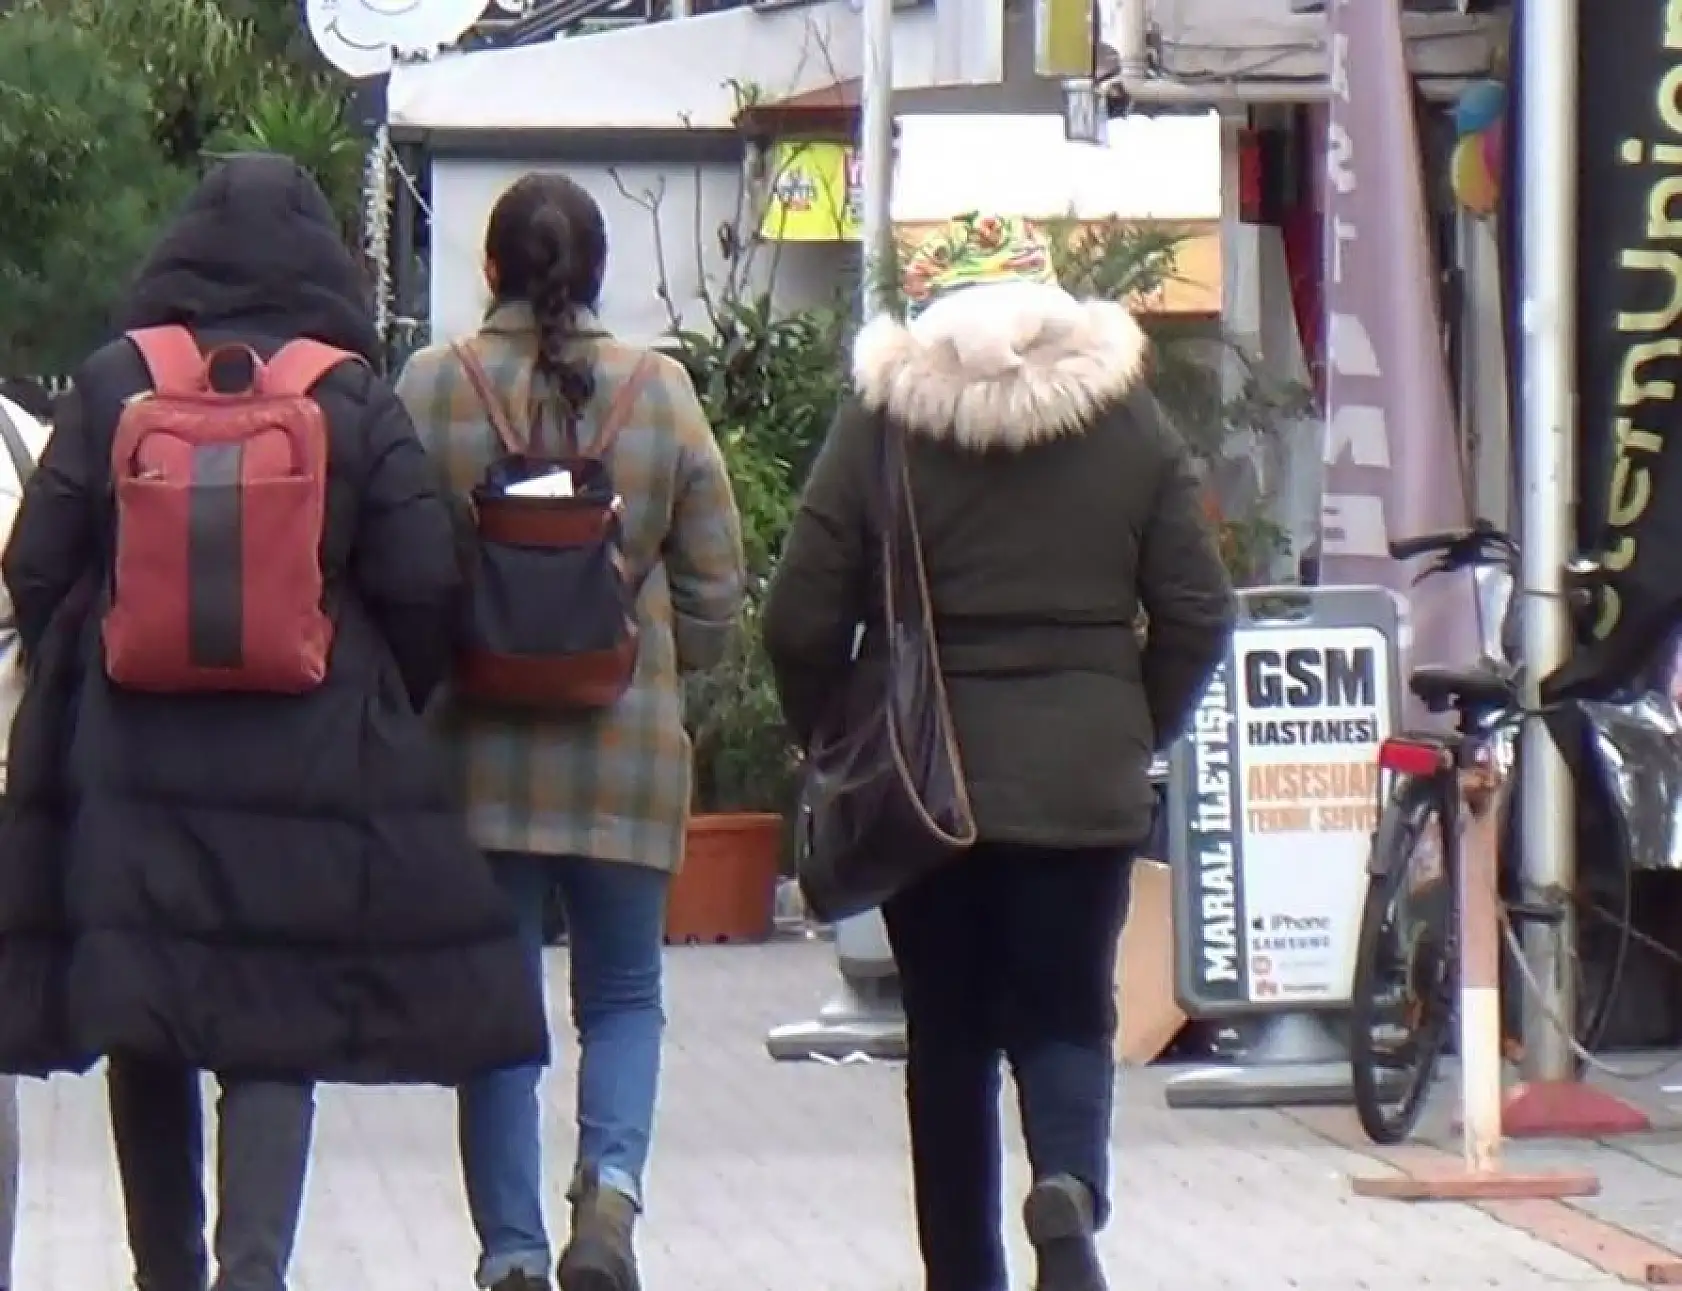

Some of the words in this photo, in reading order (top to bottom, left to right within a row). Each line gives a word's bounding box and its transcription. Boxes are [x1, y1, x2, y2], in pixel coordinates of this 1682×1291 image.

[1245, 648, 1375, 709] GSM
[1247, 713, 1378, 747] HASTANESİ
[1201, 842, 1238, 983] MARAL
[1270, 914, 1330, 931] iPhone
